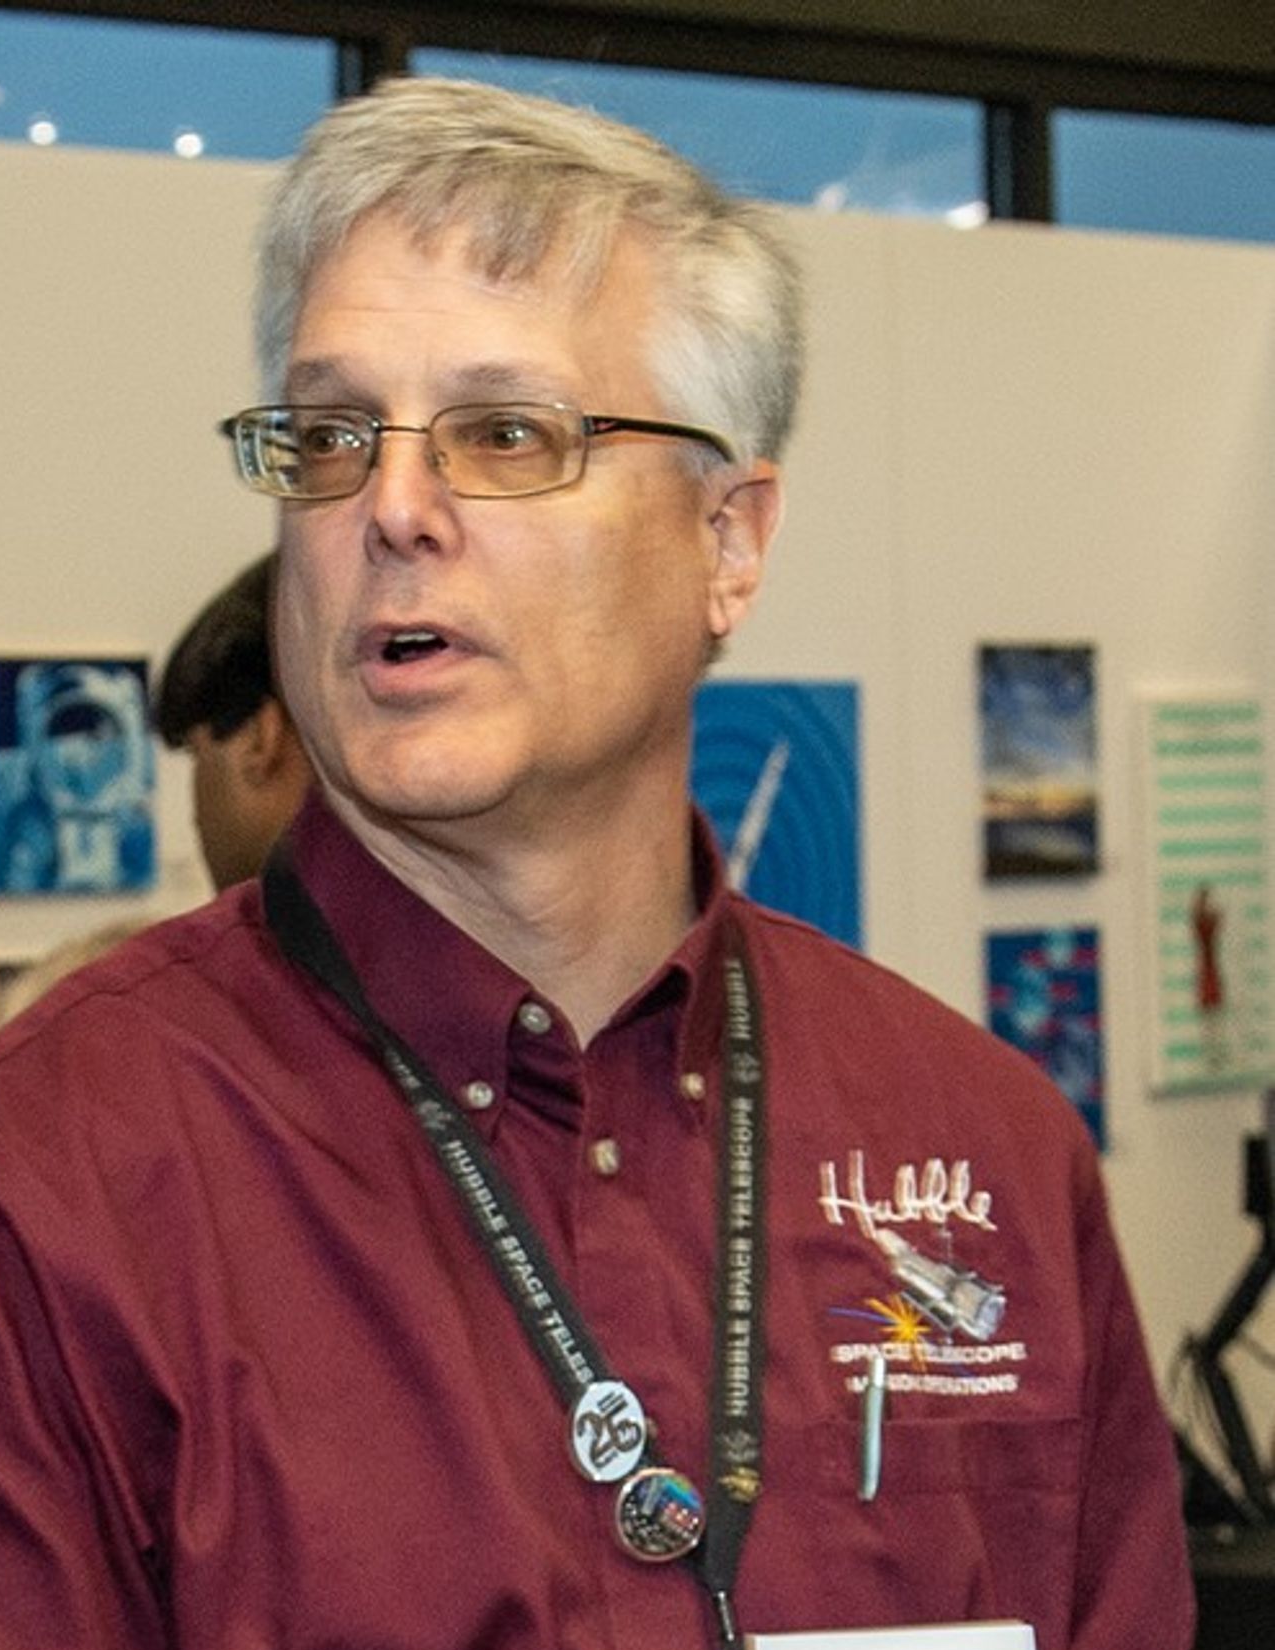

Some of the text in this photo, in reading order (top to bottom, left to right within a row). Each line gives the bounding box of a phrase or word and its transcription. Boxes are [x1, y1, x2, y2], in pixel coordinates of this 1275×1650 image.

[443, 1139, 595, 1385] HUBBLE SPACE TELES
[726, 1098, 753, 1416] HUBBLE SPACE TELESCOPE
[819, 1149, 998, 1239] Hubble
